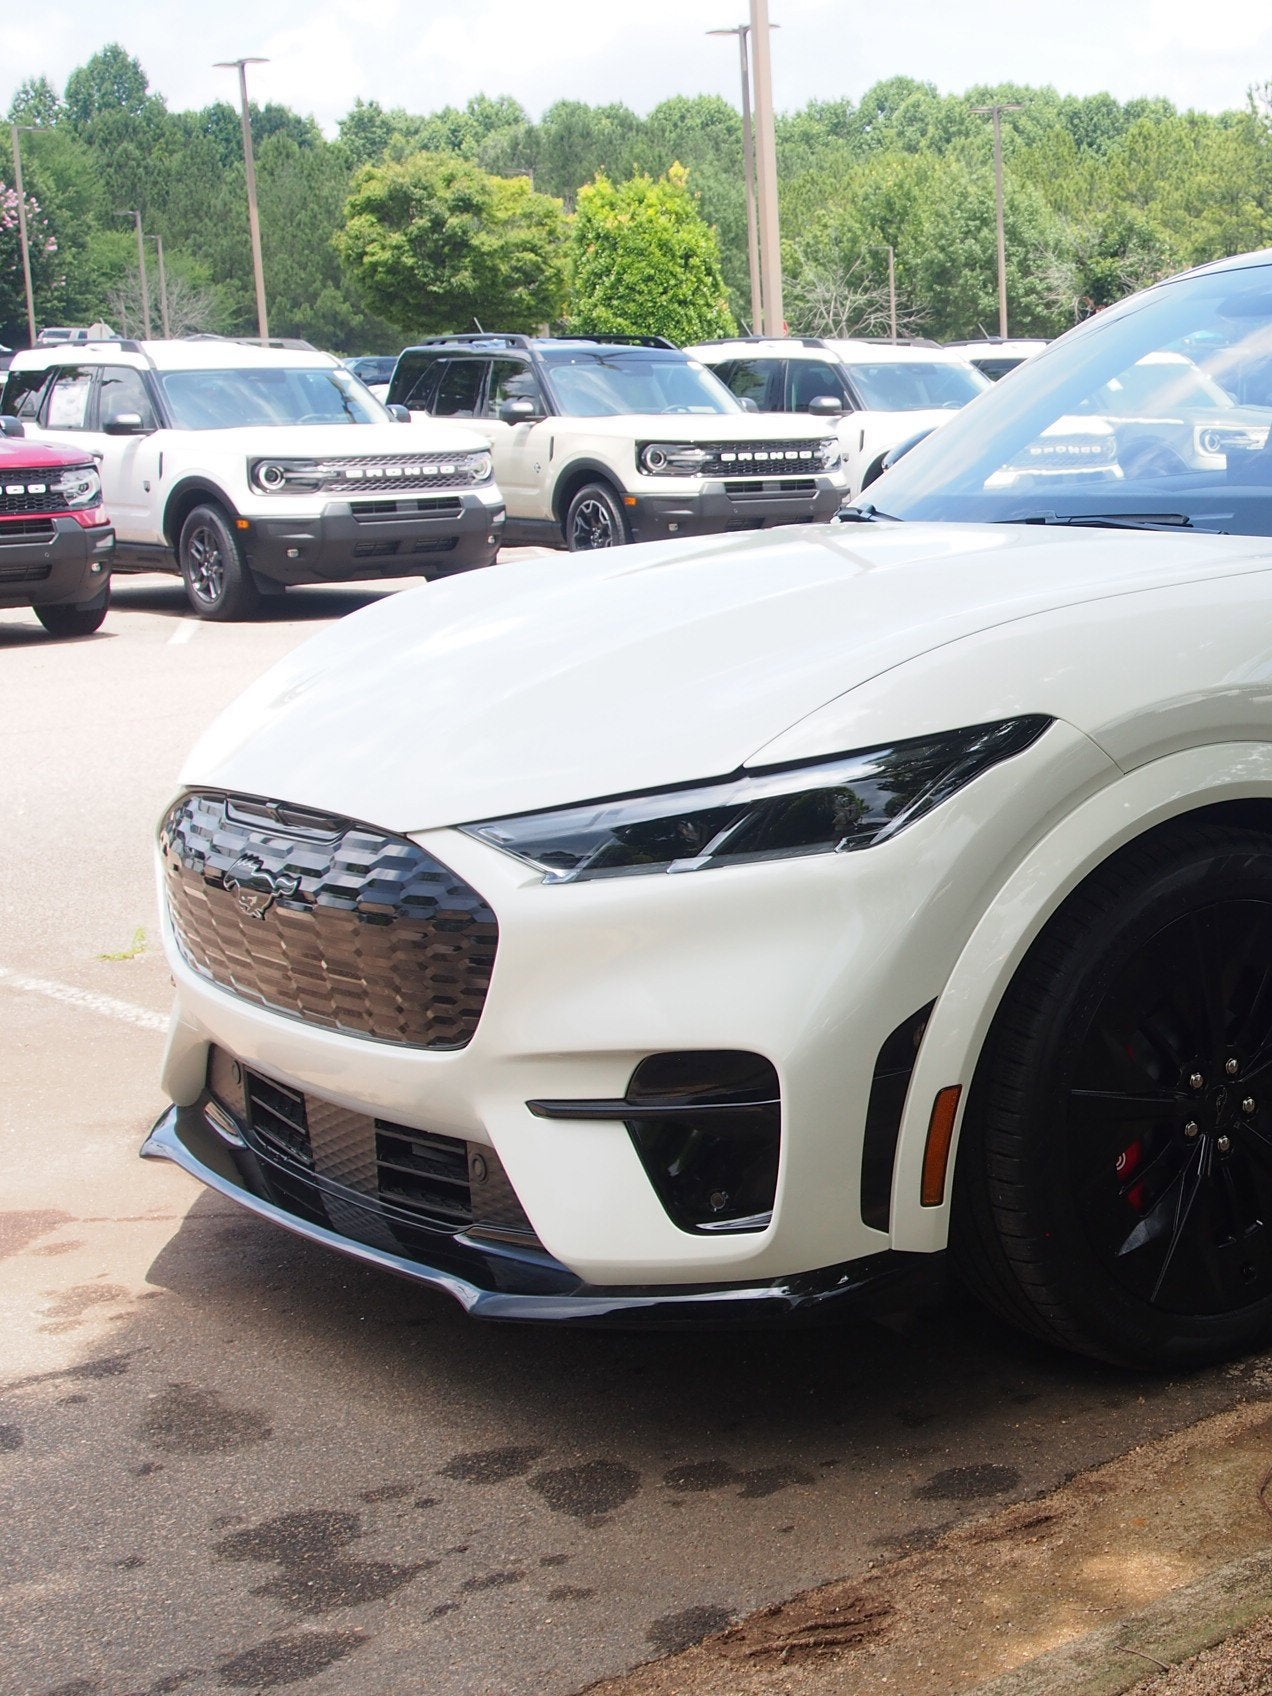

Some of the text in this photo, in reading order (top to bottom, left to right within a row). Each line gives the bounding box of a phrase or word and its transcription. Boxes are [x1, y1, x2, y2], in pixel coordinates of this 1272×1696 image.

[1030, 446, 1101, 455] BRONCO
[721, 451, 812, 461] BRONCO
[345, 465, 455, 478] BRONCO
